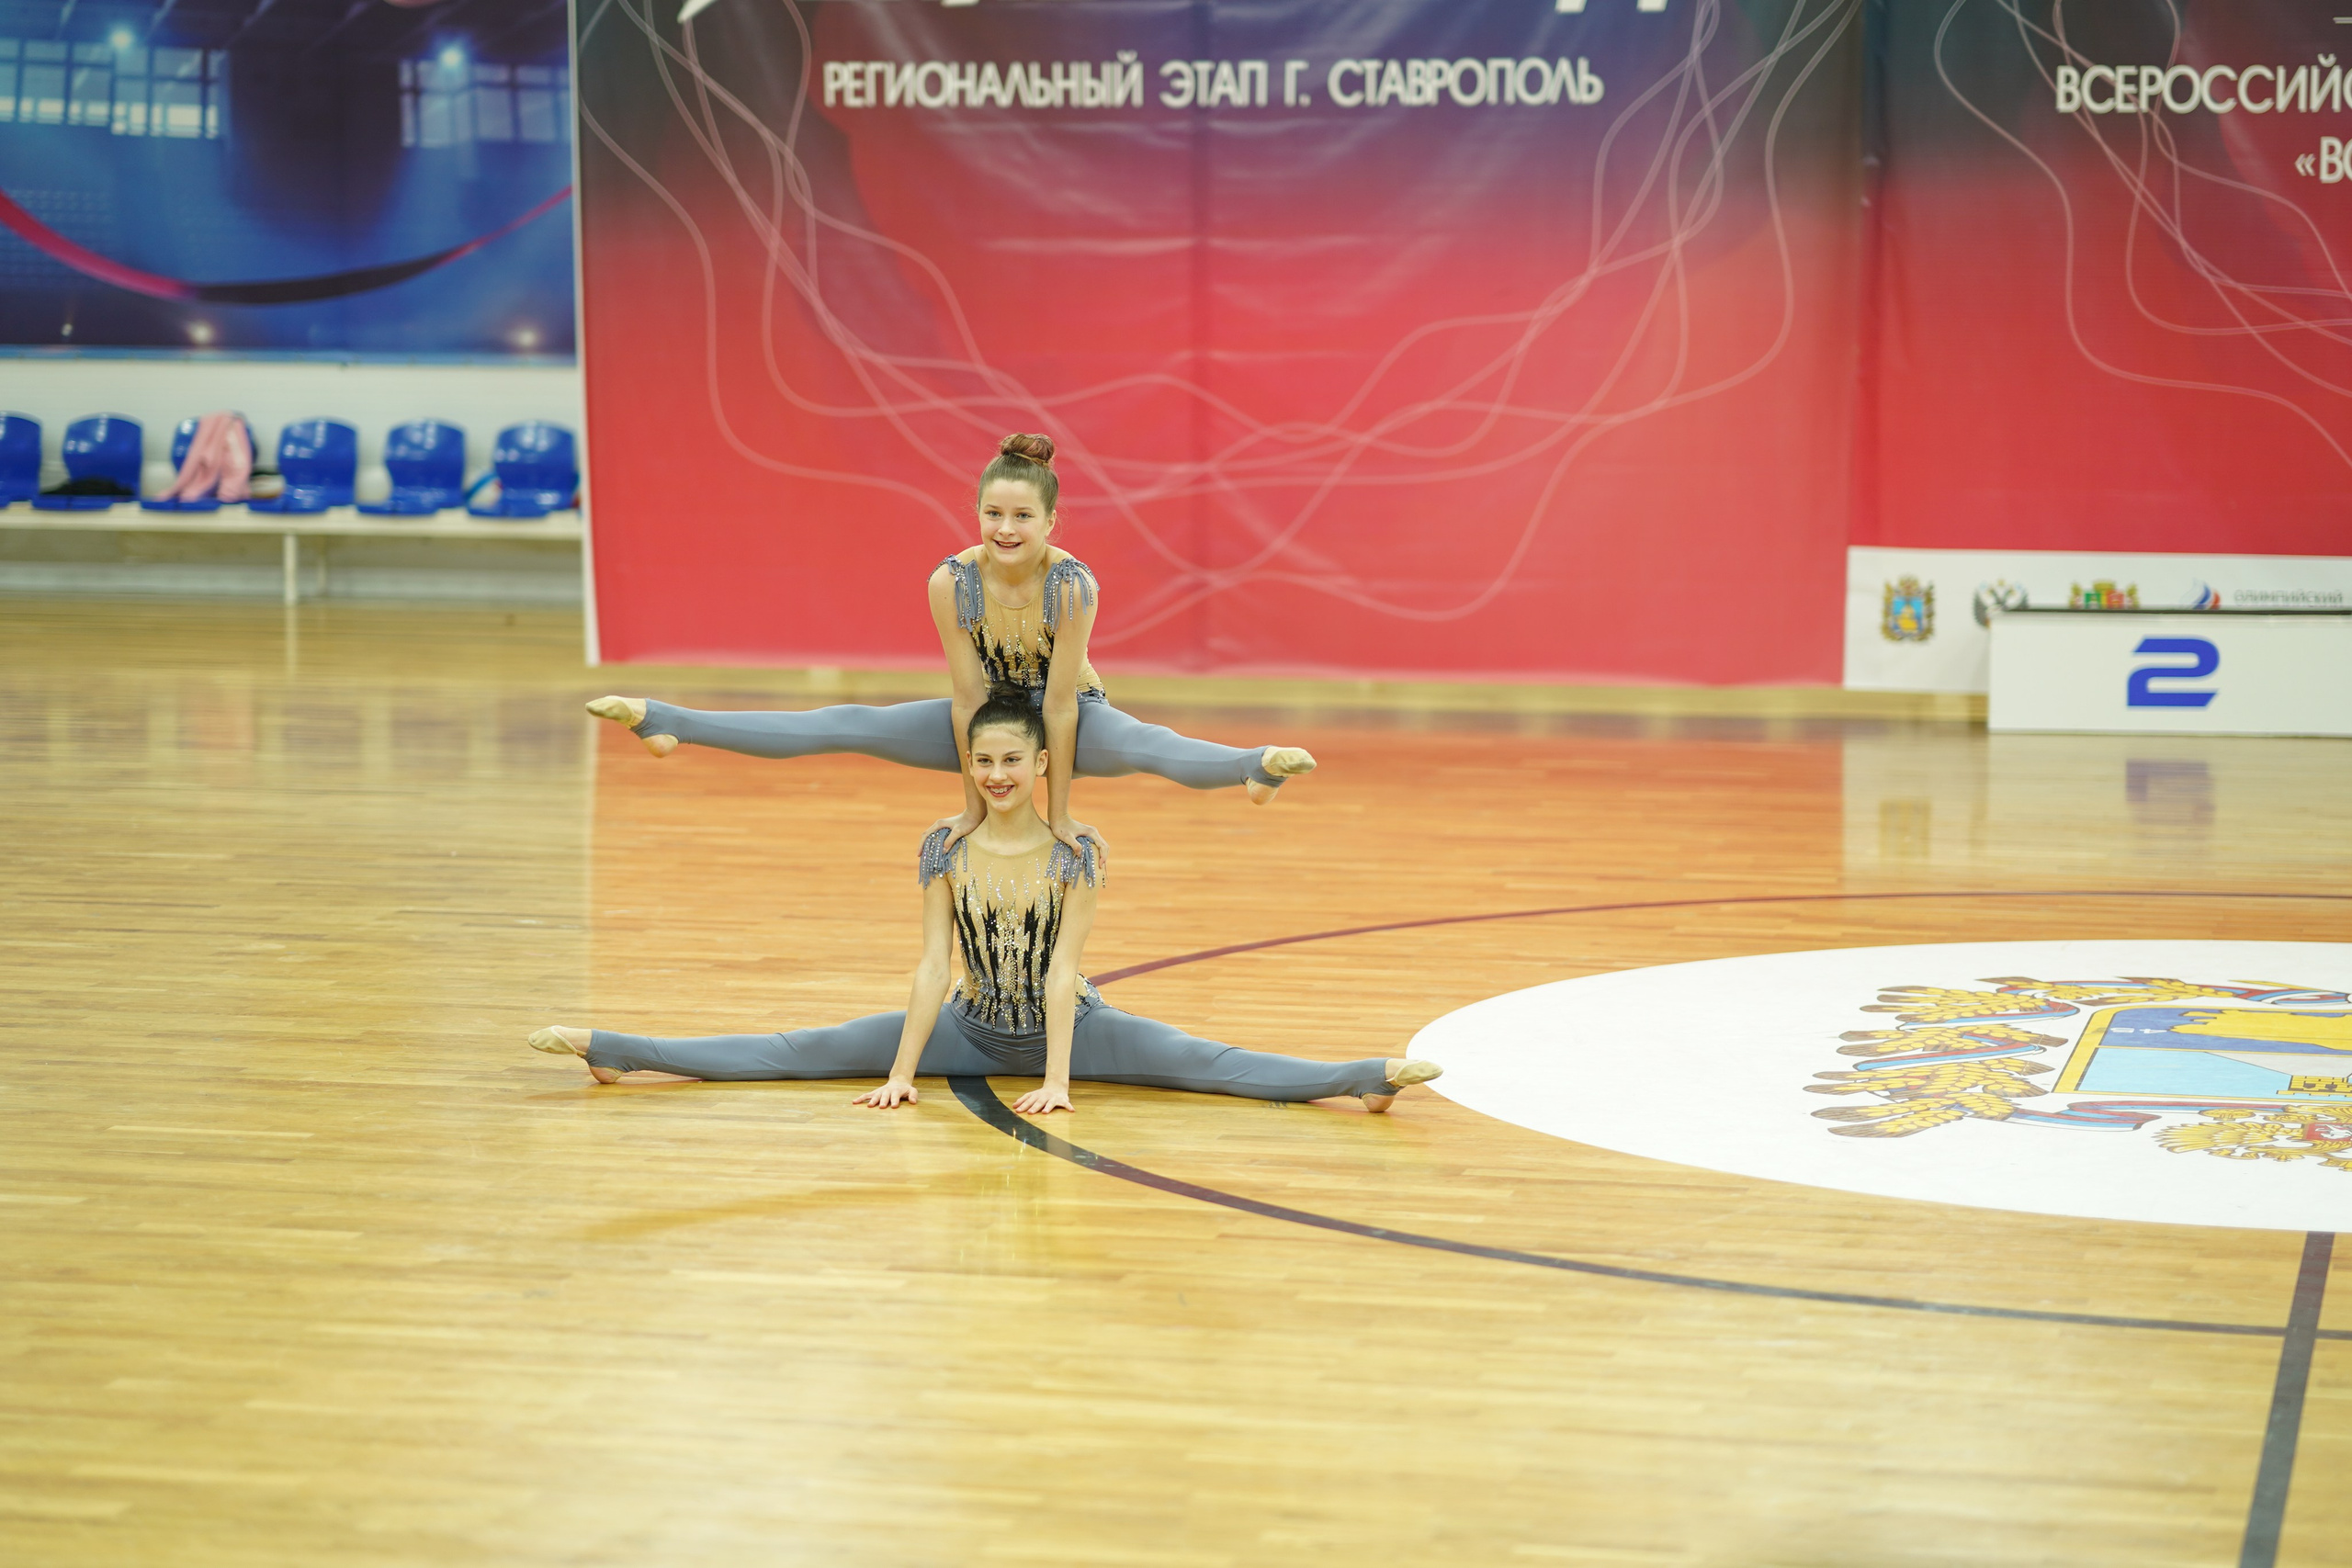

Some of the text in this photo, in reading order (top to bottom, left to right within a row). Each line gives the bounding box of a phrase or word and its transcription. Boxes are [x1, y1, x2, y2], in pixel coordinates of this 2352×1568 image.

[823, 51, 1605, 108] РЕГИОНАЛЬНЫЙ ЭТАП Г. СТАВРОПОЛЬ
[2055, 53, 2352, 114] ВСЕРОССИЙ
[2294, 136, 2352, 184] «В
[2127, 637, 2221, 707] 2
